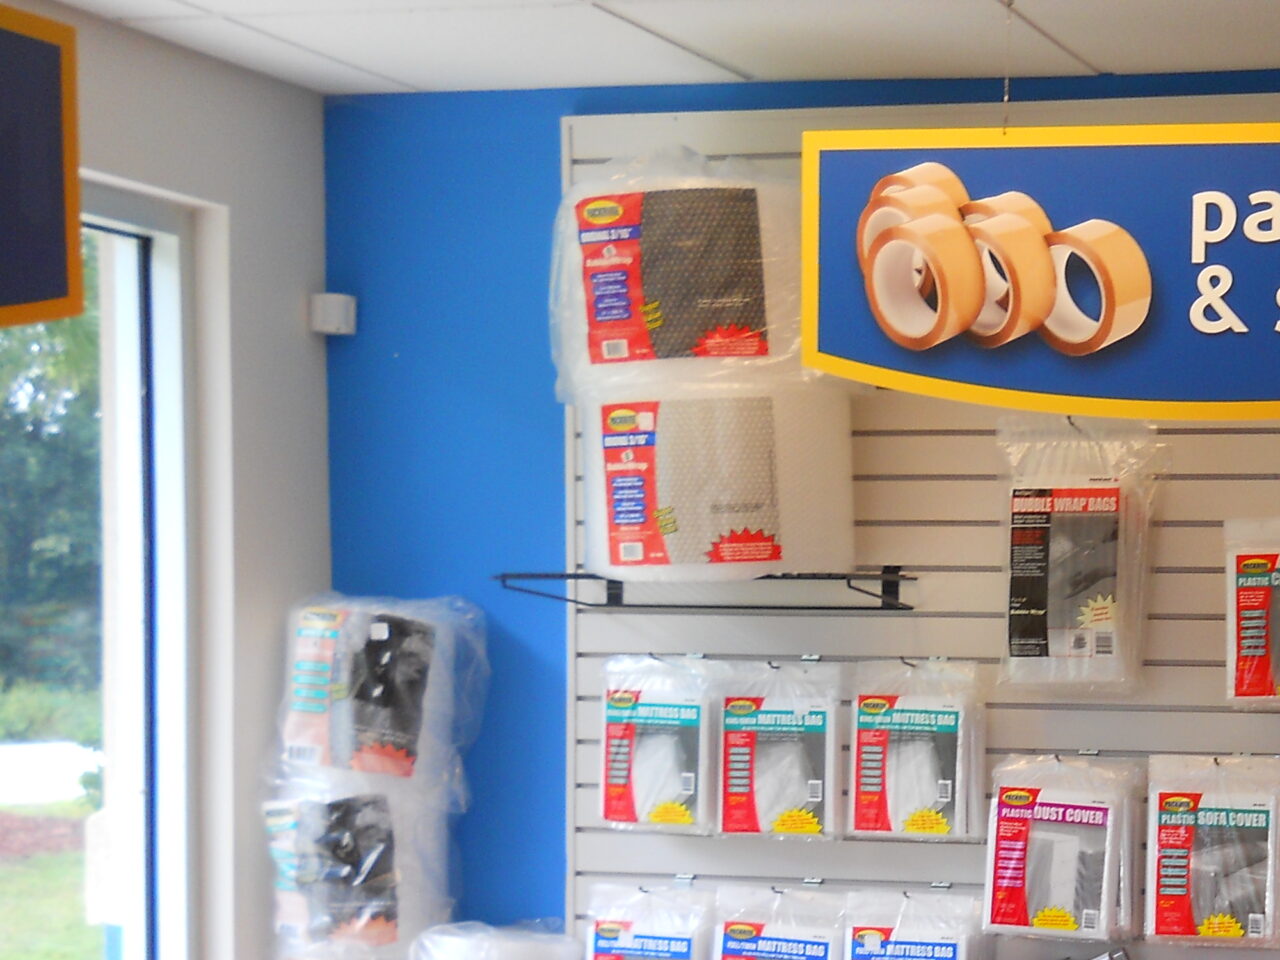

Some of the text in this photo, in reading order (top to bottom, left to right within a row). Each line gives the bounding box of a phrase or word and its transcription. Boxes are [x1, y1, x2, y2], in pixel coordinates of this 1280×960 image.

[1189, 264, 1249, 334] &
[1053, 497, 1088, 512] WRAP
[1088, 497, 1117, 512] BAGS
[1033, 805, 1063, 822] DUST
[1065, 808, 1103, 824] COVER
[1161, 811, 1266, 828] PLASTIC SOFA COVER
[757, 939, 804, 955] MATTRESS
[805, 943, 825, 957] BAG
[886, 944, 933, 957] MATTRESS
[933, 946, 953, 958] BAG
